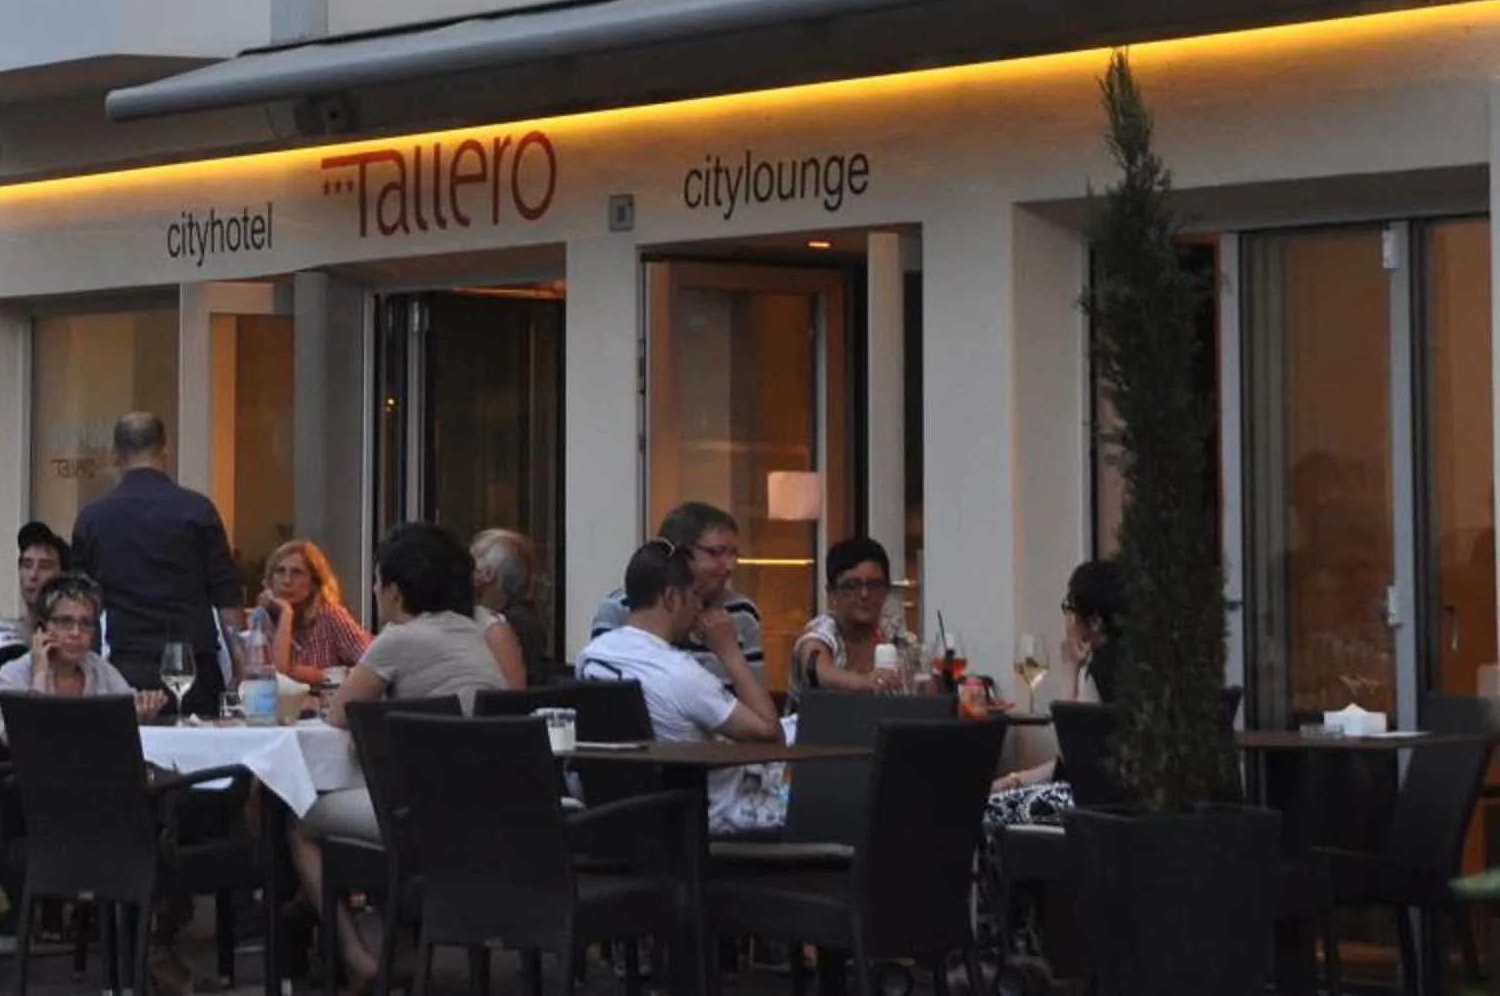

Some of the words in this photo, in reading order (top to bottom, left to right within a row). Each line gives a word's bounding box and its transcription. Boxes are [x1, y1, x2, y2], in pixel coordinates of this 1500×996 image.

[320, 129, 557, 237] Tallero
[683, 149, 870, 221] citylounge
[166, 202, 273, 267] cityhotel
